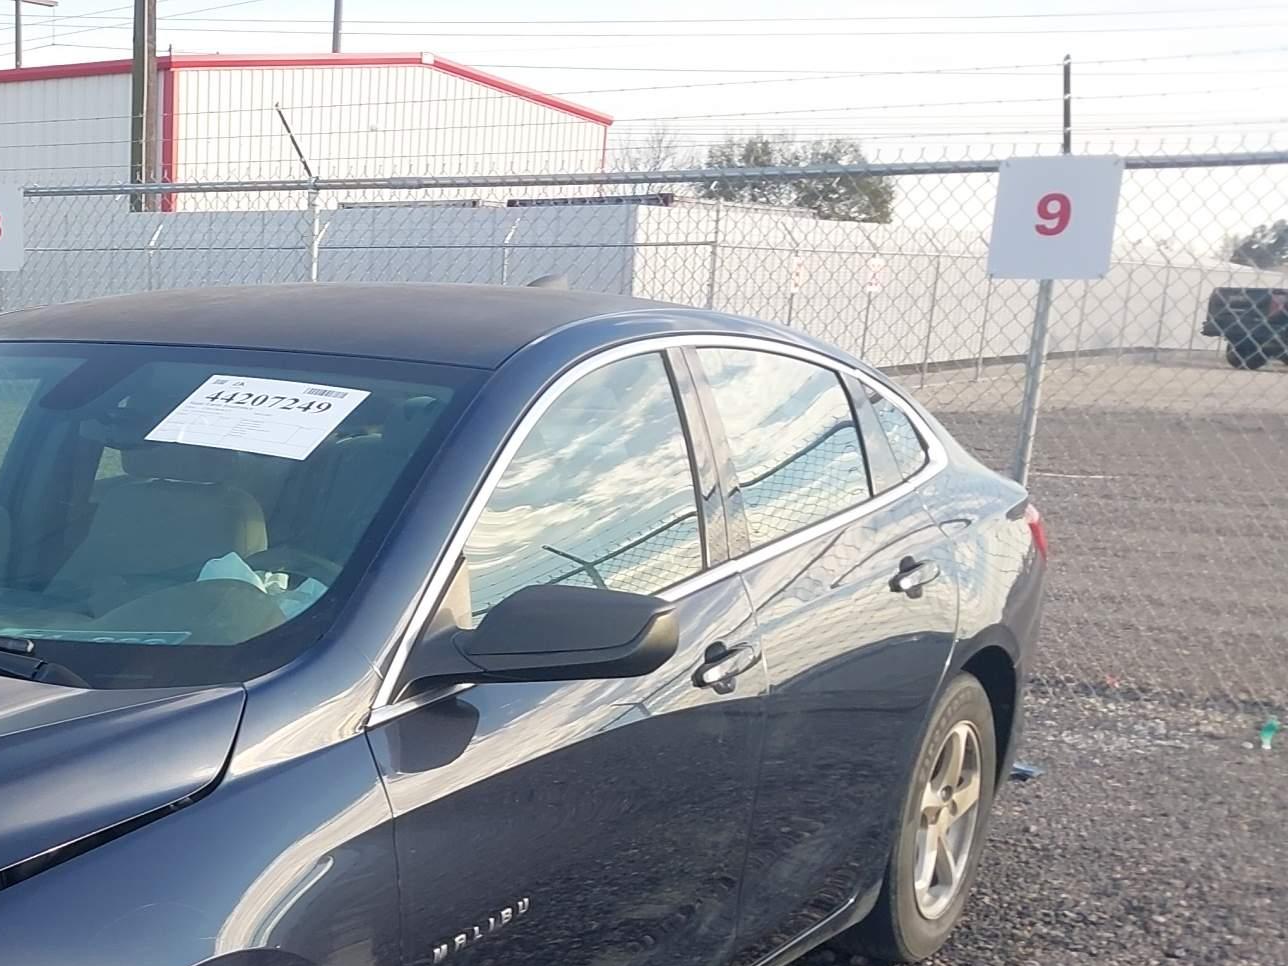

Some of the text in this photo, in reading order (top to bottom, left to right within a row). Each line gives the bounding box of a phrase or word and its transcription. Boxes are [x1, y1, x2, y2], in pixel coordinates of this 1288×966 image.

[1034, 192, 1072, 237] 9
[205, 390, 333, 414] 44207249
[433, 897, 530, 964] MALIBU
